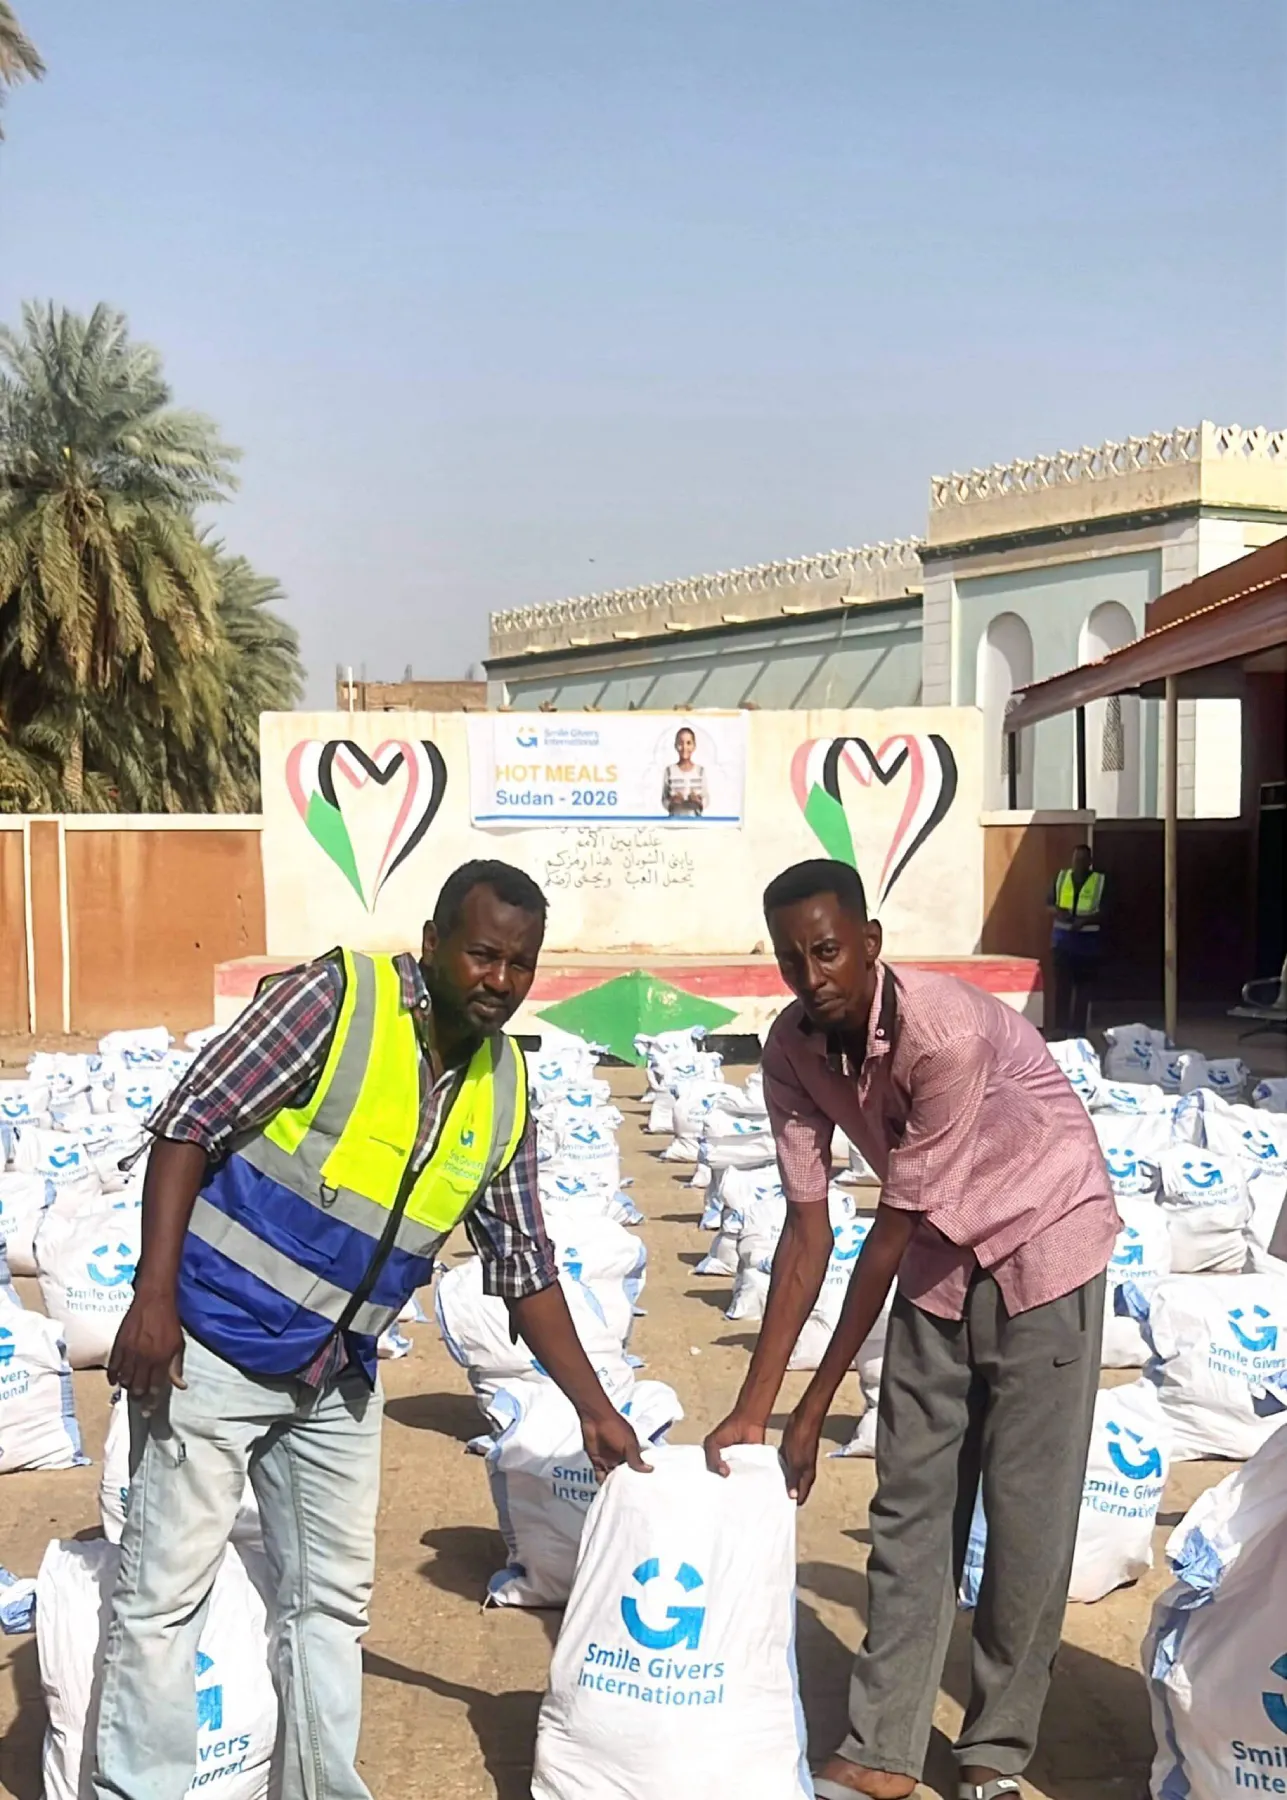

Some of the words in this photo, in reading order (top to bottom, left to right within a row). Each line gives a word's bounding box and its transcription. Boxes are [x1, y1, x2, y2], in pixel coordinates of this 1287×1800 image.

[495, 764, 542, 782] HOT
[545, 764, 618, 782] MEALS
[496, 789, 554, 806] Sudan
[571, 790, 618, 806] 2026
[66, 1286, 105, 1300] Smile
[108, 1289, 133, 1301] Giv
[1209, 1342, 1248, 1367] Smile
[0, 1369, 31, 1383] vers
[552, 1466, 594, 1484] Smil
[1083, 1479, 1130, 1498] mile
[584, 1642, 641, 1673] Smile
[647, 1657, 726, 1680] Givers
[577, 1667, 725, 1706] International
[199, 1733, 252, 1762] vers
[1231, 1740, 1287, 1769] Smil
